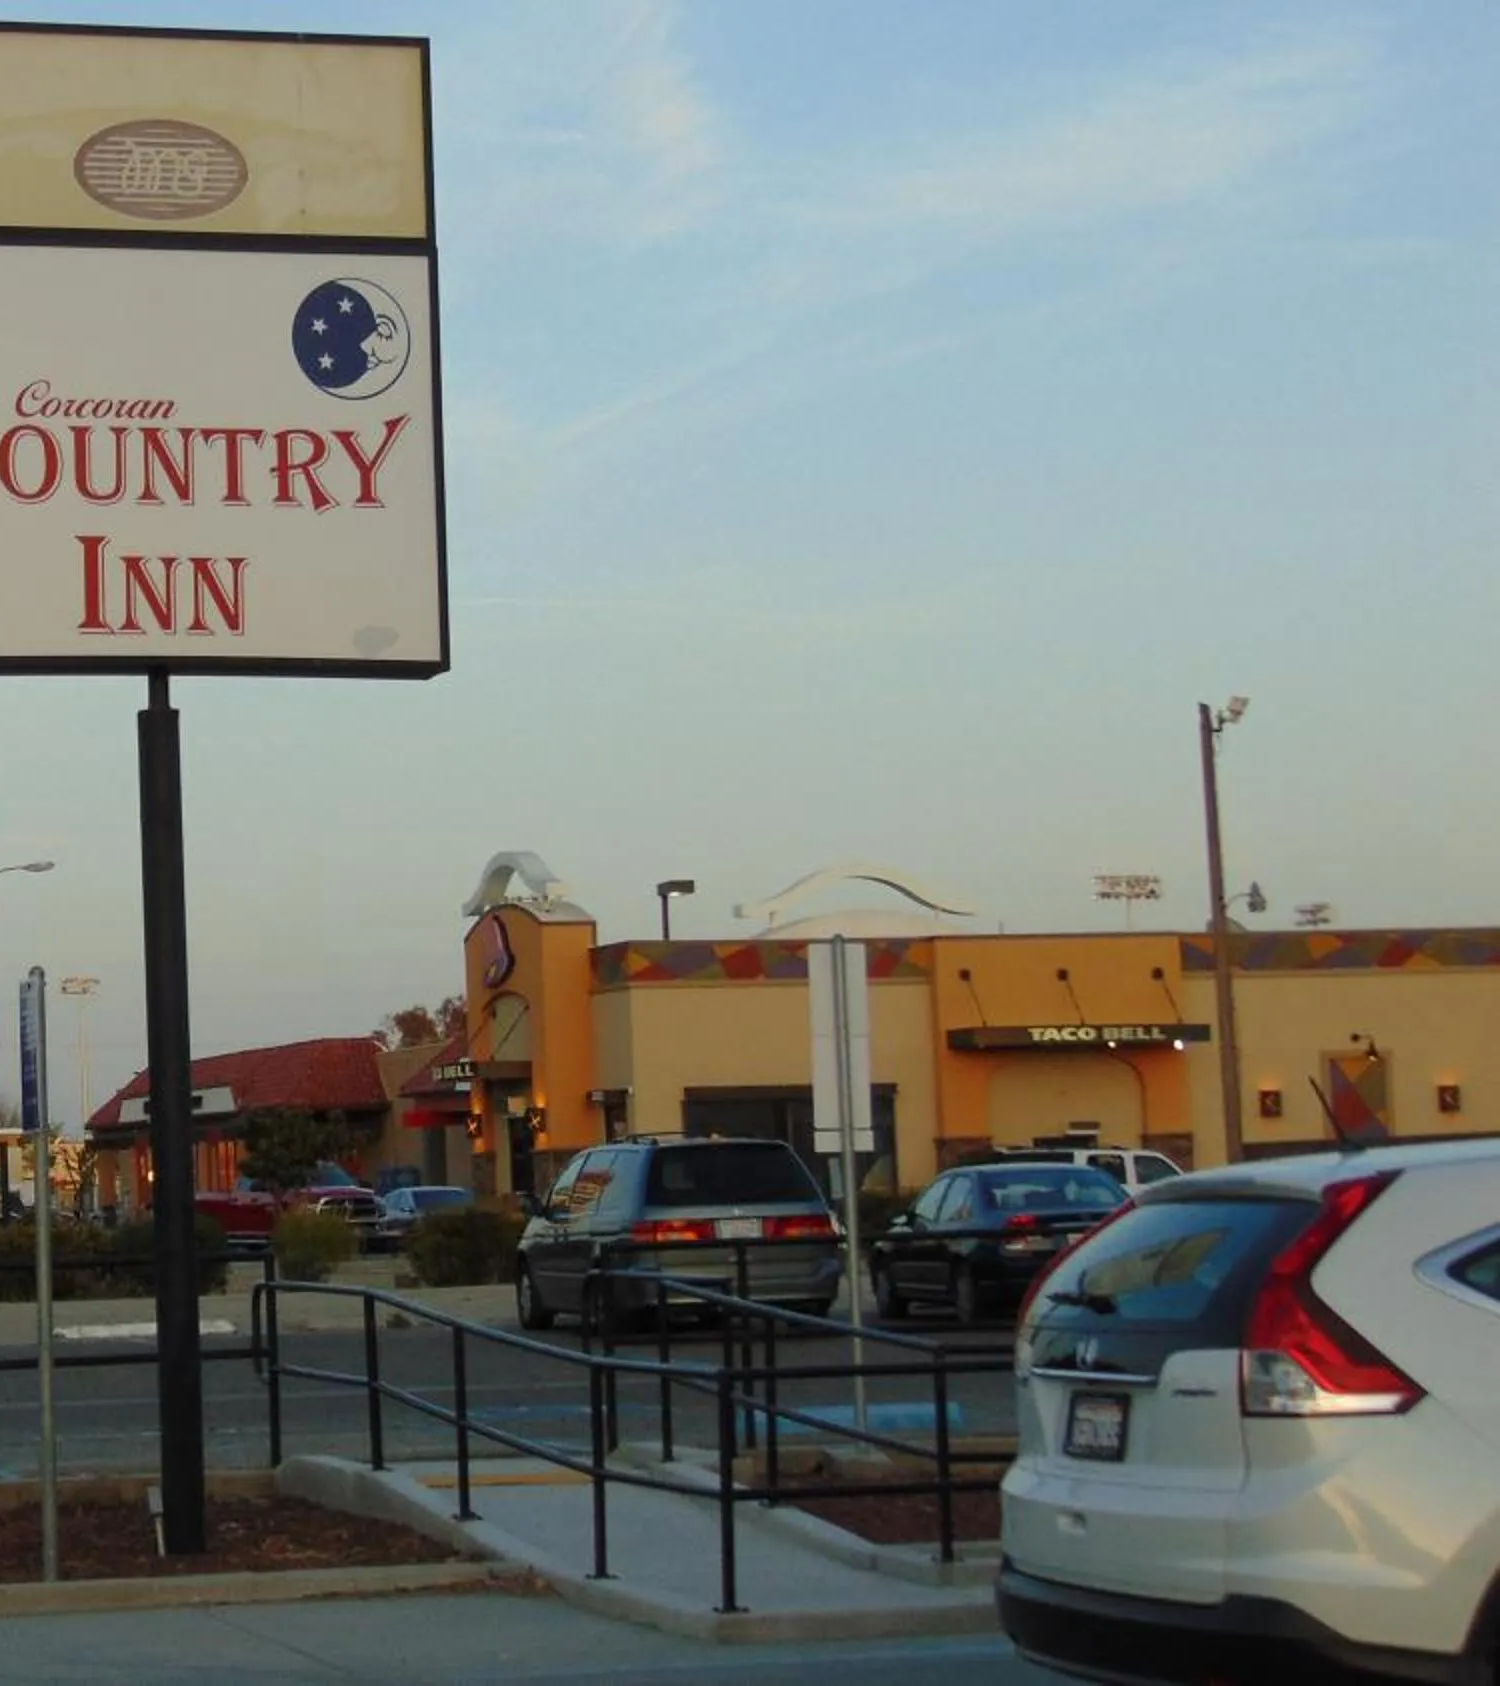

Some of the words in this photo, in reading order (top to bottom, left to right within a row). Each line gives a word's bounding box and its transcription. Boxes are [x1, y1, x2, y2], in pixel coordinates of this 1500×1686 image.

[14, 379, 178, 420] Corcoran
[74, 534, 250, 636] INN
[1027, 1026, 1098, 1041] TACO
[1102, 1026, 1167, 1040] BELL
